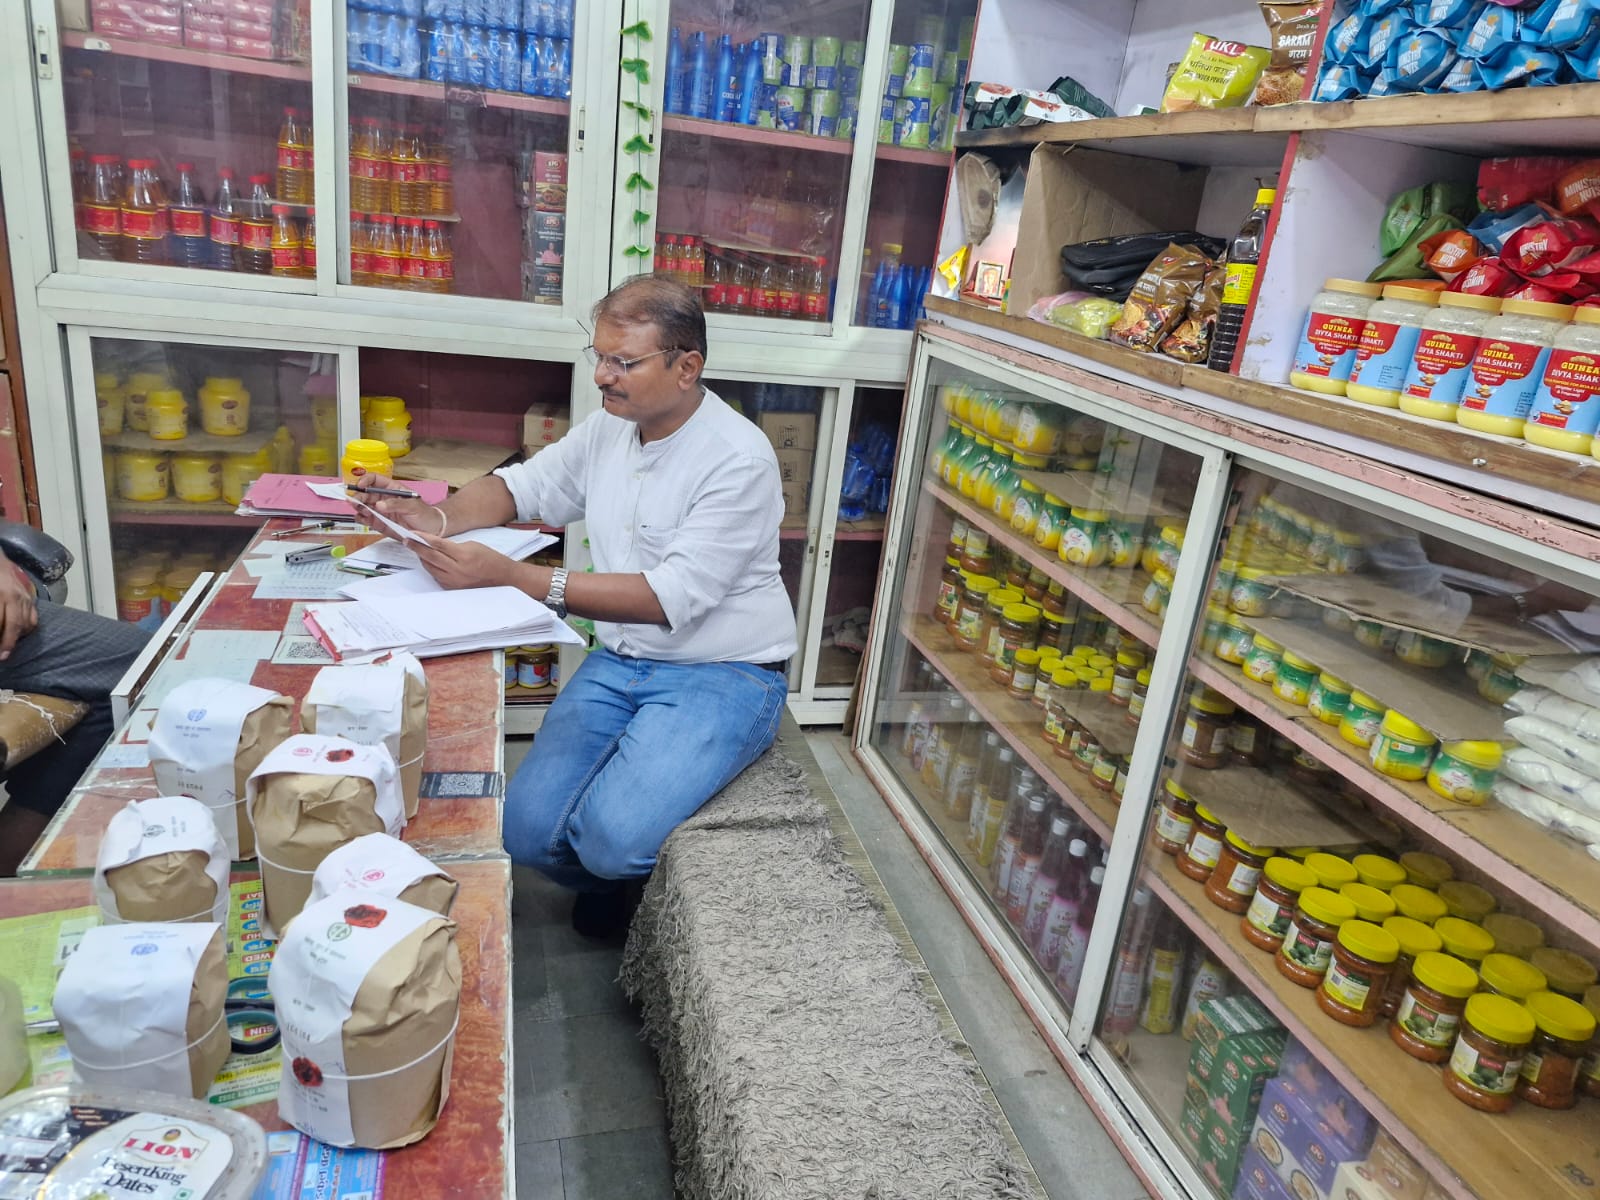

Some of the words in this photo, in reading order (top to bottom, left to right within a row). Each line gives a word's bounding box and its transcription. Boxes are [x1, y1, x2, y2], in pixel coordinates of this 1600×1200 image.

[1322, 324, 1353, 334] GUINEA
[1333, 332, 1358, 341] SHAKTI
[1425, 340, 1457, 351] GUINEA
[1434, 349, 1464, 360] SHAKTI
[1482, 348, 1514, 360] GUINEA
[1491, 359, 1522, 370] SHAKTI
[1561, 361, 1600, 375] GUINEA
[1551, 368, 1572, 380] DIVYA
[1573, 373, 1600, 383] SHAK
[244, 952, 272, 963] WED
[249, 1025, 274, 1037] SUN
[123, 1138, 200, 1159] LION
[104, 1170, 158, 1194] Dates
